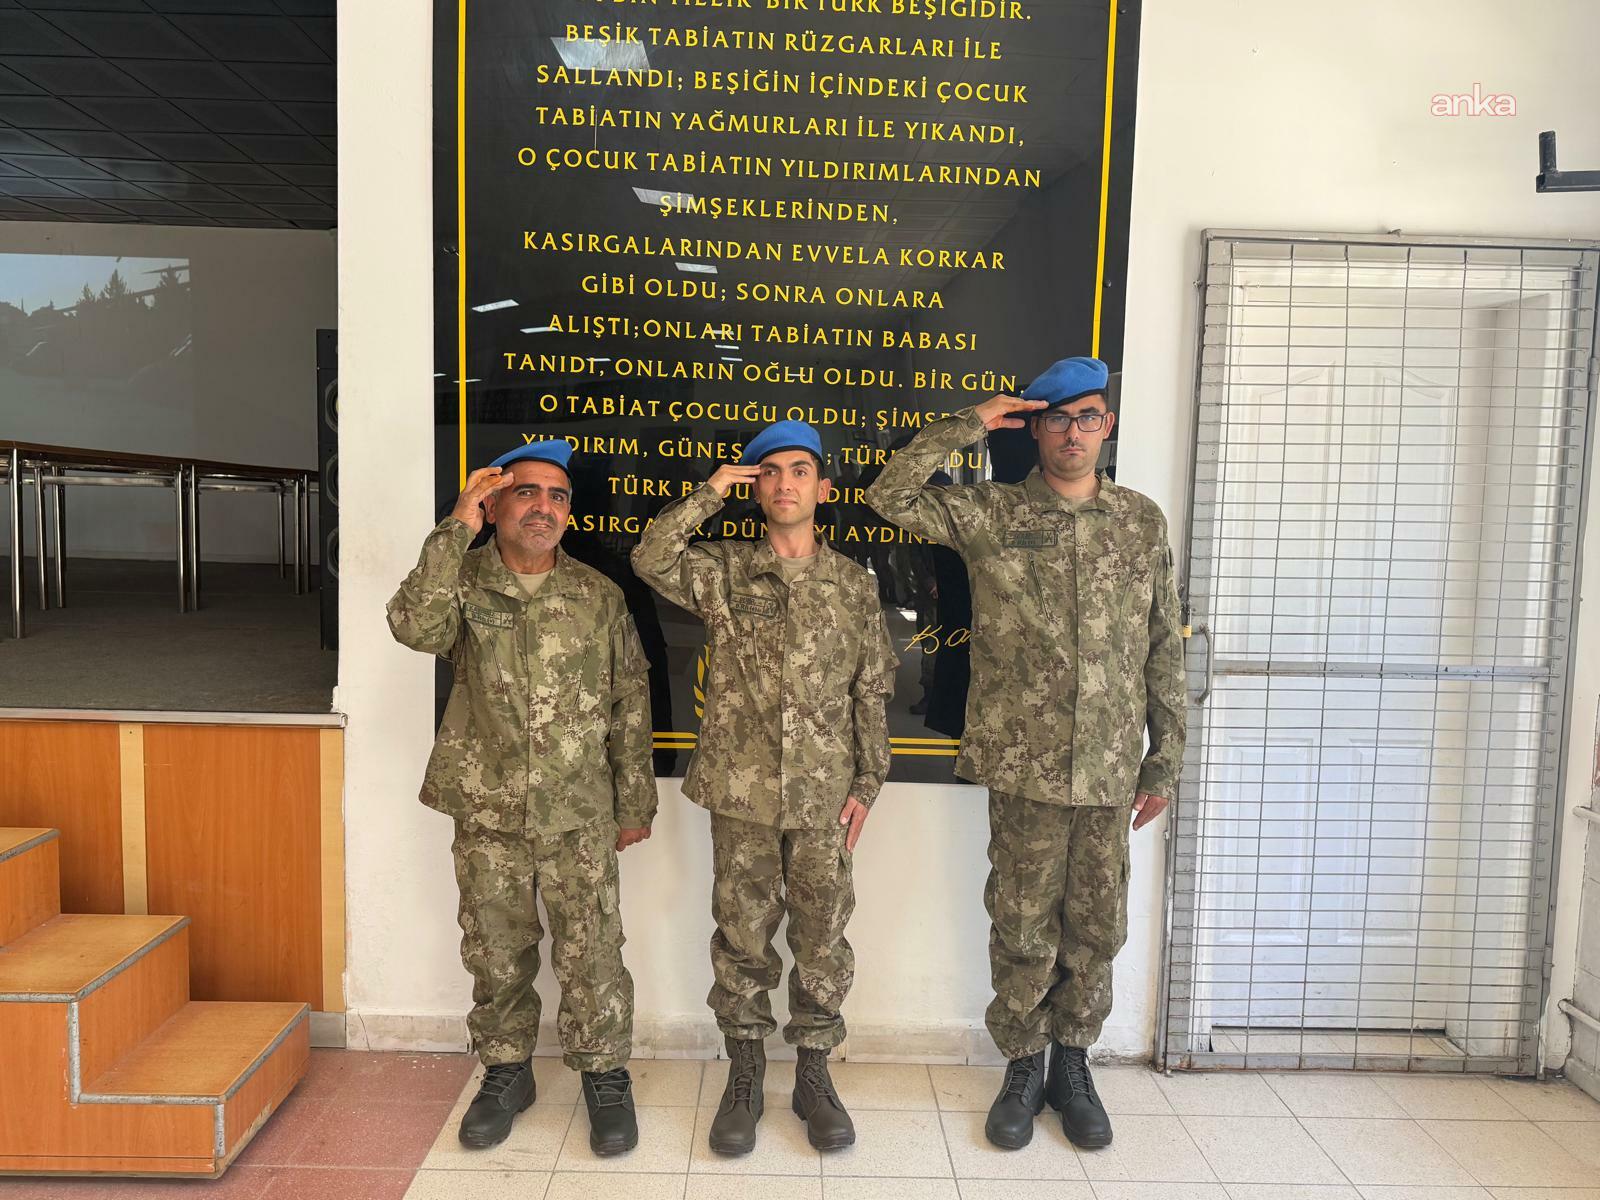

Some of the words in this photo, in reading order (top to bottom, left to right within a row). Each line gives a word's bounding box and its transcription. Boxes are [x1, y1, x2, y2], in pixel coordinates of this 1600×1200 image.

[565, 22, 640, 48] BEŞİK
[648, 26, 775, 50] TABİATIN
[784, 30, 955, 58] RÜZGARLARI
[963, 37, 1002, 60] İLE
[536, 64, 684, 91] SALLANDI;
[693, 68, 800, 96] BEŞİĞİN
[808, 71, 928, 99] İÇİNDEKİ
[936, 80, 1029, 104] ÇOCUK
[535, 105, 662, 130] TABİATIN
[670, 109, 847, 138] YAĞMURLARI
[856, 116, 895, 140] İLE
[904, 120, 1025, 148] YIKANDI,
[517, 147, 537, 167] O
[545, 148, 638, 171] ÇOCUK
[646, 151, 772, 178] TABİATIN
[780, 159, 1042, 188] YILDIRIMLARINDAN
[659, 192, 899, 225] ŞİMŞEKLERİNDEN,
[524, 231, 783, 261] KASIRGALARINDAN
[792, 243, 891, 266] EVVELA
[899, 248, 1006, 270] KORKAR
[581, 272, 636, 296] GİBİ
[644, 278, 727, 302] OLDU;
[736, 282, 826, 305] SONRA
[835, 287, 945, 310] ONLARA
[751, 322, 873, 348] TABİATIN
[882, 329, 978, 351] BABASI
[503, 352, 605, 377] TANIDI,
[614, 357, 734, 381] ONLARIN
[743, 361, 811, 387] OĞLU
[823, 367, 903, 388] OLDU.
[913, 367, 954, 390] BİR
[539, 394, 558, 413] O
[566, 394, 661, 419] TABİAT
[668, 398, 777, 424] ÇOCUĞU
[786, 405, 866, 428] OLDU;
[658, 437, 743, 464] GÜNEŞ
[841, 444, 896, 466] TÜR
[607, 472, 673, 498] TÜRK
